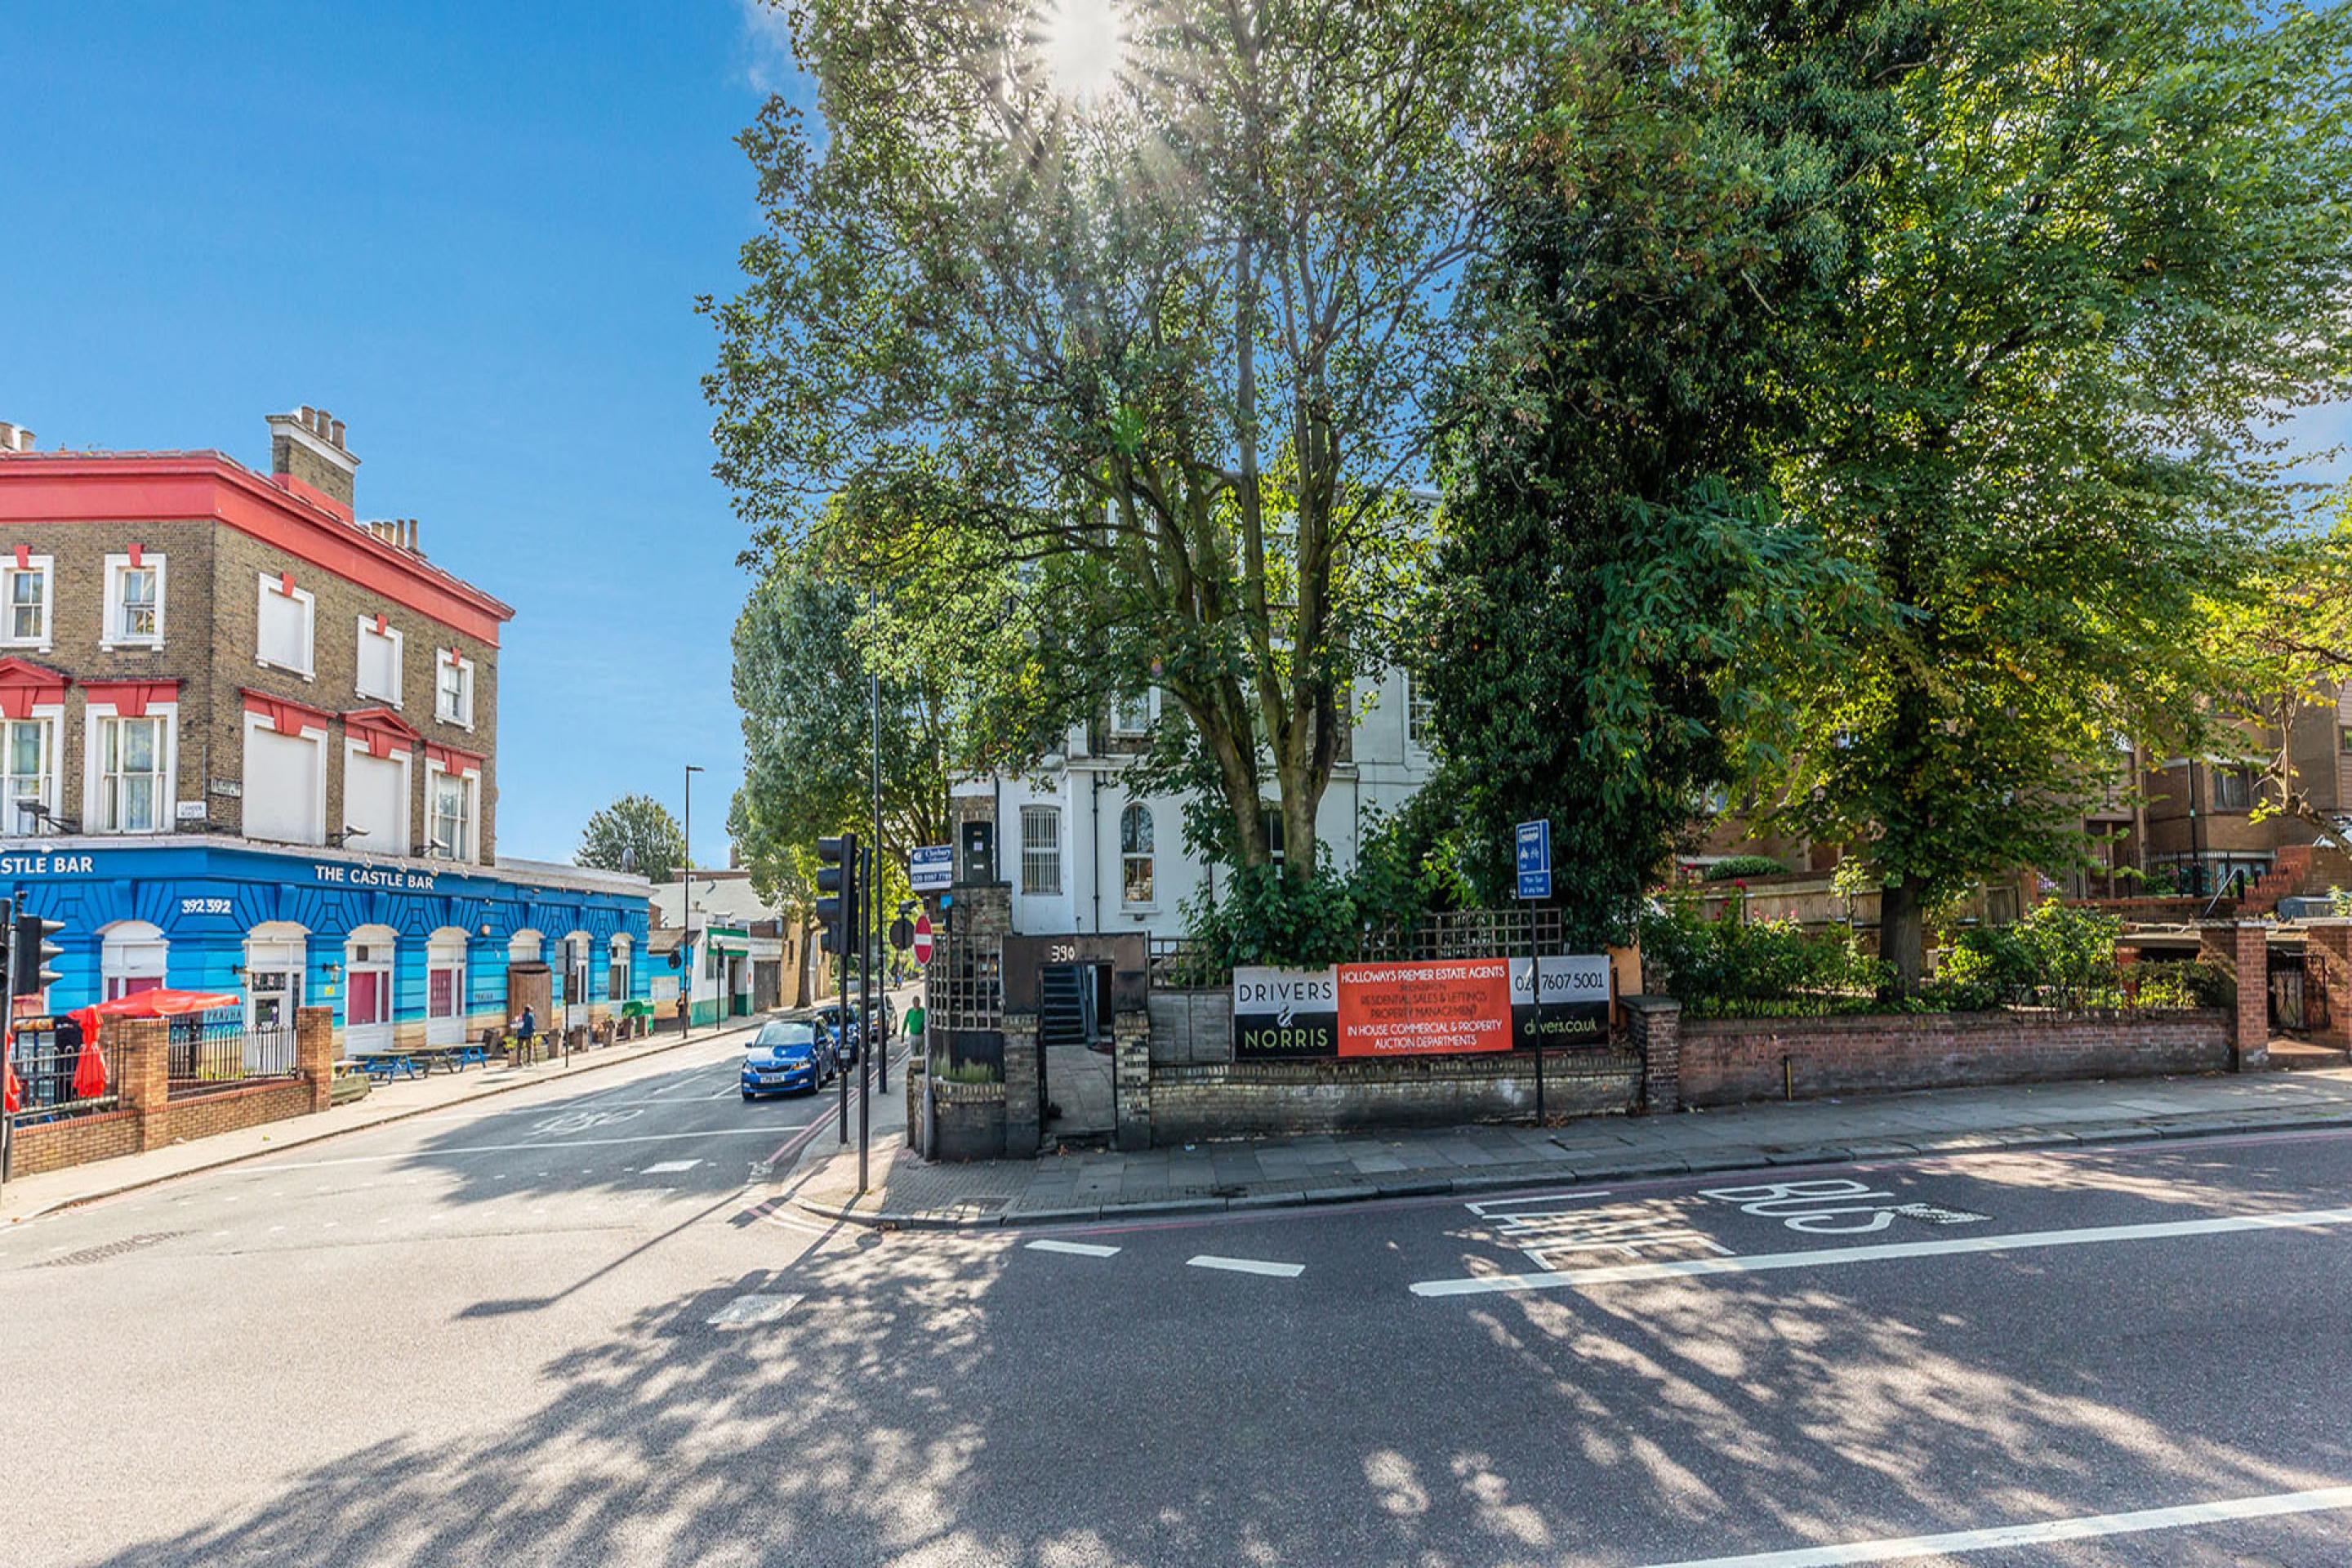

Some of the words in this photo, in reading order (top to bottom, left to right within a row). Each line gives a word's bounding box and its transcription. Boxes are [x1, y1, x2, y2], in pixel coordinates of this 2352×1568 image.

[54, 857, 93, 873] BAR
[314, 864, 344, 882] THE
[350, 869, 403, 887] CASTLE
[408, 875, 434, 889] BAR
[182, 898, 205, 914] 392
[207, 898, 231, 914] 392
[1051, 945, 1076, 962] 390
[1341, 970, 1396, 983] HOLLOWAYS
[1398, 969, 1434, 982] PREMIER
[1436, 968, 1466, 980] ESTATE
[1468, 965, 1505, 978] AGENTS
[1515, 975, 1535, 991] 02
[1542, 973, 1571, 990] 7607
[1574, 972, 1604, 989] 5001
[1239, 982, 1332, 1002] DRIVERS
[1413, 992, 1438, 1004] SALES
[1348, 1026, 1357, 1036] IN
[1359, 1024, 1388, 1036] HOUSE
[1390, 1022, 1449, 1035] COMMERCIAL
[1459, 1019, 1503, 1032] PROPERTY
[1245, 1028, 1329, 1049] NORRIS
[1374, 1037, 1415, 1049] AUCTION
[1416, 1034, 1477, 1048] DEPARTMENTS
[1698, 1178, 1897, 1234] BUS
